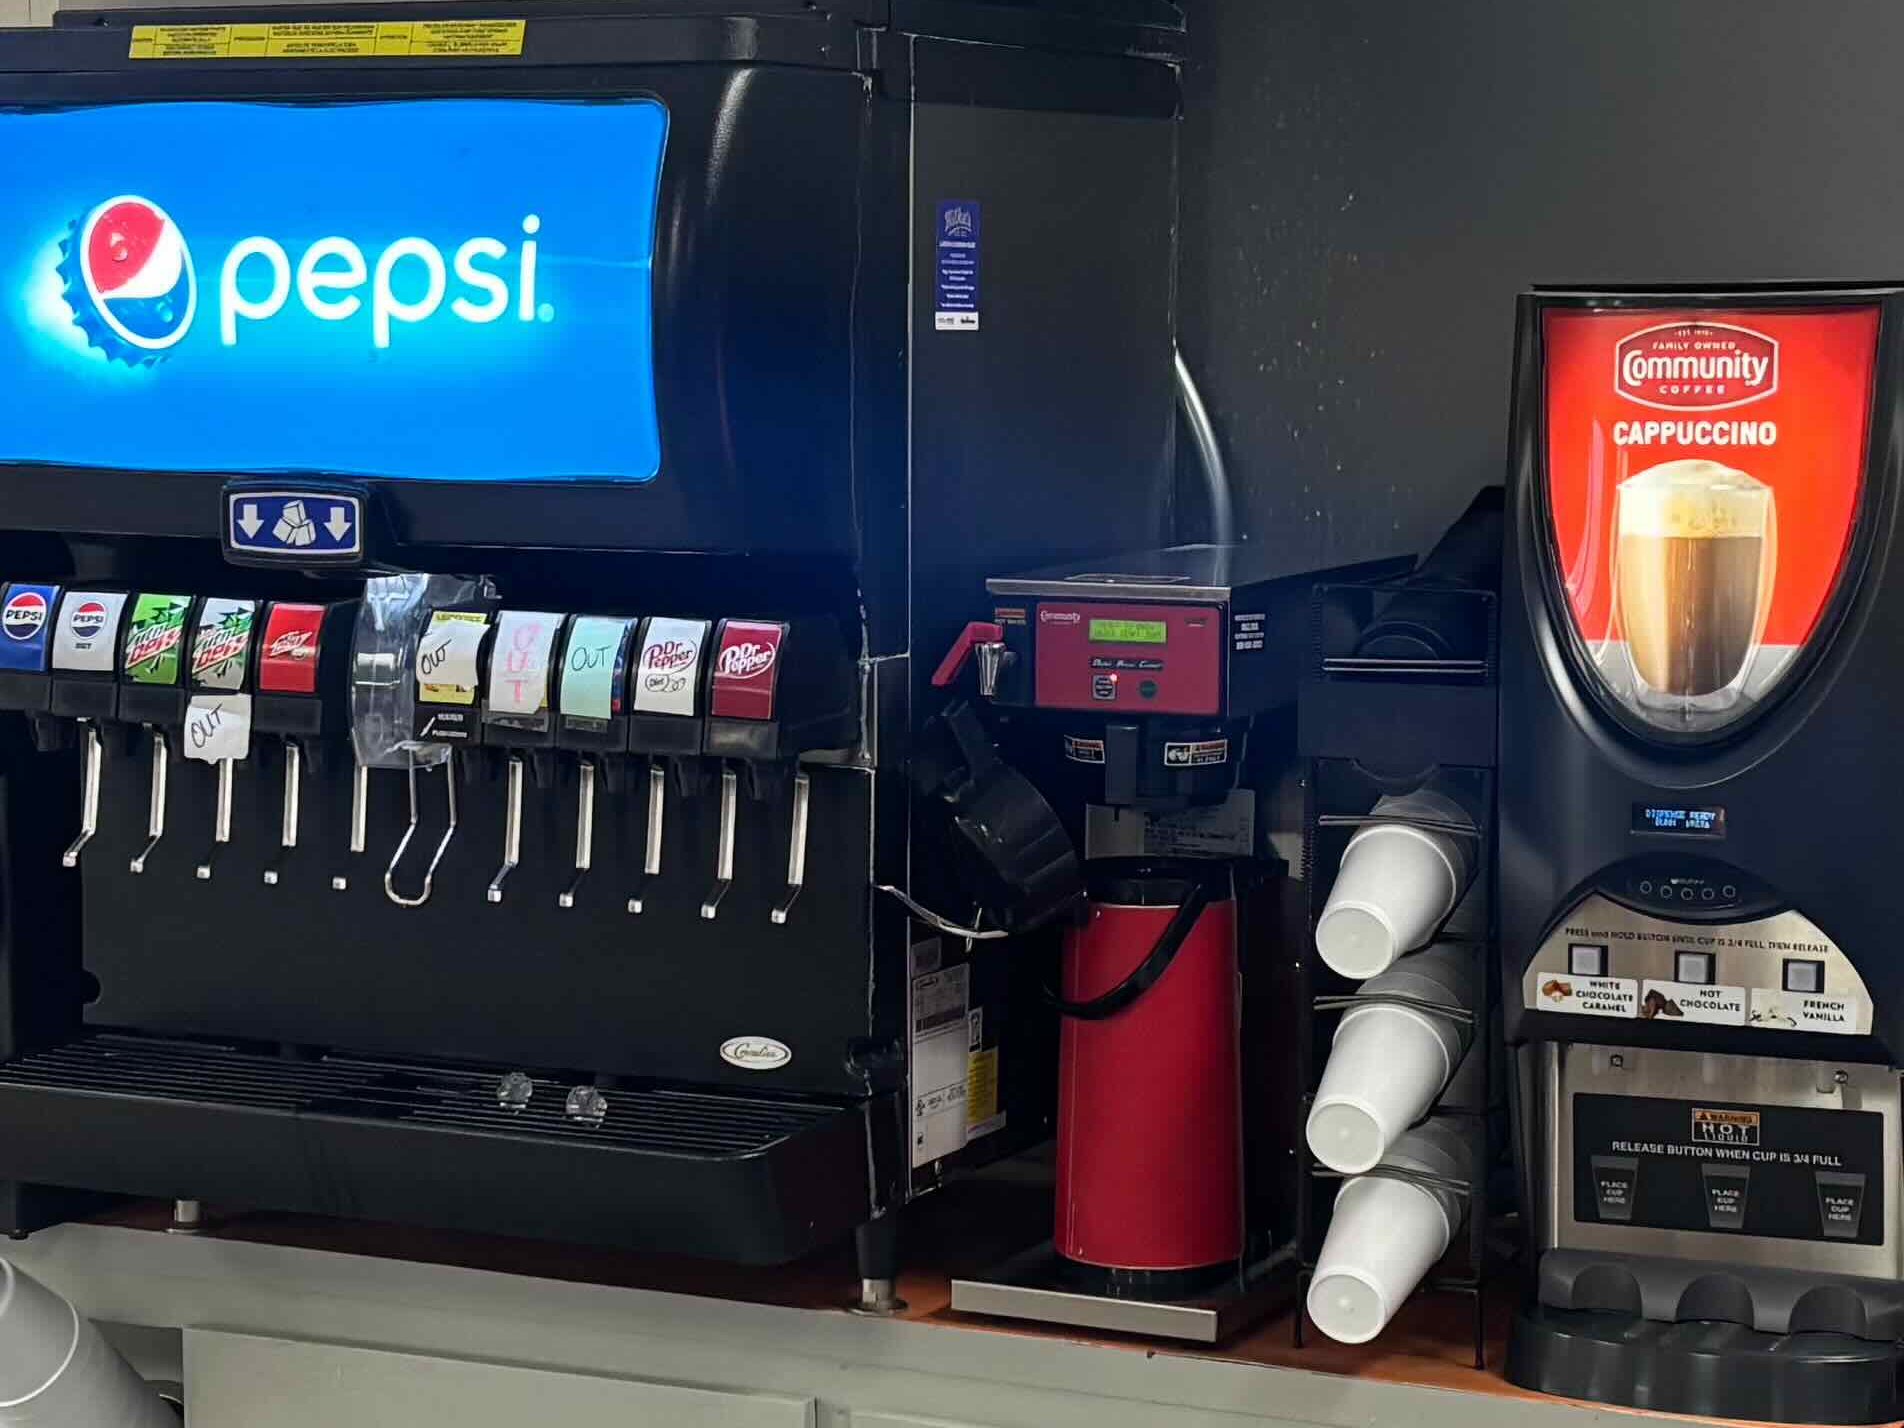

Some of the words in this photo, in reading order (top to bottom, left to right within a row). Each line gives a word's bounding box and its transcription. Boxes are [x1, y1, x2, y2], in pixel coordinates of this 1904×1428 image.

[219, 214, 539, 349] pepsi
[1652, 342, 1689, 350] FAMILY
[1694, 341, 1736, 350] OWNED
[1622, 348, 1769, 387] Community
[1659, 385, 1726, 395] COFFEE
[1613, 421, 1778, 446] CAPPUCCINO
[5, 609, 44, 620] PEPSI
[72, 614, 104, 623] PEPSI
[663, 641, 684, 654] Dr
[740, 643, 761, 656] Dr
[421, 638, 452, 675] OUT
[572, 645, 611, 672] OUT
[647, 643, 694, 670] Pepper
[726, 646, 772, 674] Pepper
[190, 703, 223, 749] OUT
[1565, 927, 1589, 937] PRESS
[1610, 931, 1635, 940] HOLD
[1697, 935, 1716, 946] CUP
[1589, 980, 1621, 991] WHITE
[1576, 989, 1634, 1003] CHOCOLATE
[1700, 988, 1722, 999] HOT
[1582, 1000, 1627, 1013] CARAMEL
[1679, 998, 1741, 1013] CHOCOLATE
[1803, 999, 1846, 1011] FRENCH
[1802, 1010, 1846, 1023] VANILLA
[1702, 1122, 1751, 1136] HOT
[1704, 1132, 1749, 1143] LIQUID
[1612, 1141, 1665, 1155] RELEASE
[1667, 1145, 1714, 1159] BUTTON
[1715, 1148, 1751, 1161] WHEN
[1752, 1150, 1778, 1162] CUP
[1779, 1153, 1792, 1164] IS
[1812, 1155, 1843, 1167] FULL
[1601, 1180, 1628, 1190] PLACE
[1606, 1188, 1624, 1197] CUP
[1712, 1188, 1741, 1198] PLACE
[1603, 1196, 1627, 1205] HERE
[1717, 1196, 1736, 1205] CUP
[1825, 1197, 1855, 1207] PLACE
[1714, 1204, 1738, 1213] HERE
[1831, 1205, 1851, 1214] CUP
[1828, 1212, 1852, 1222] HERE
